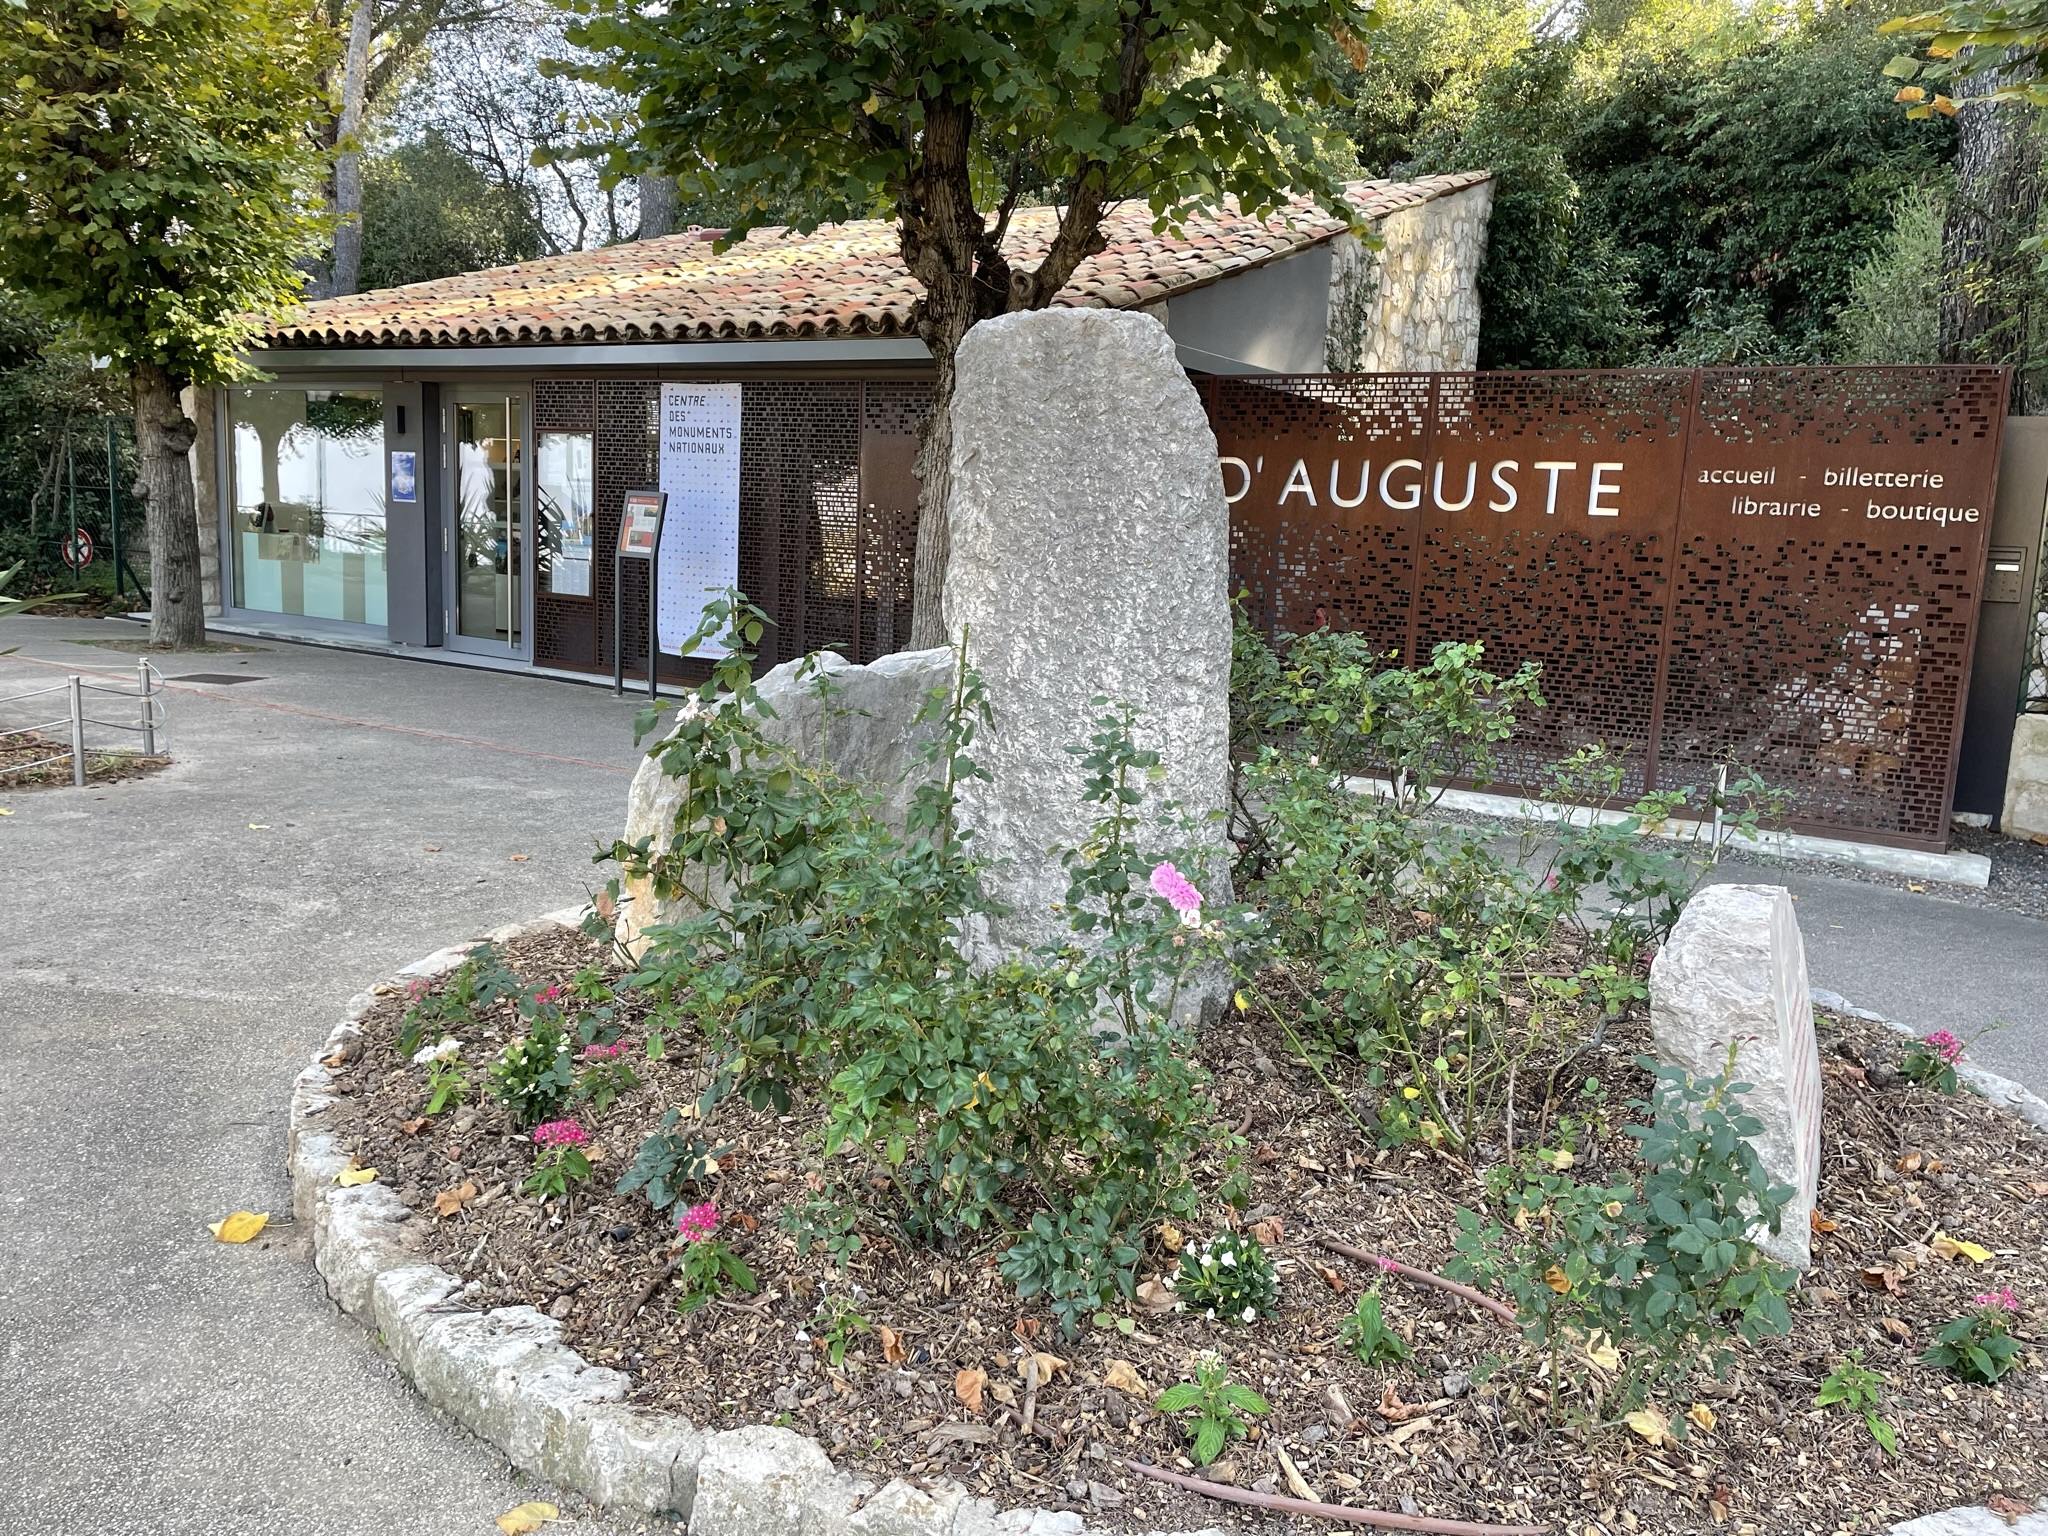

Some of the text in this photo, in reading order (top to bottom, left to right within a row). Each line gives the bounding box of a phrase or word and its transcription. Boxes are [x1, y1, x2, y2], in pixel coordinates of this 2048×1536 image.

[668, 395, 706, 407] CENTRE
[669, 410, 686, 422] DES
[669, 426, 732, 439] MONUMENTS
[669, 441, 725, 454] NATIONAUX
[1697, 466, 1776, 485] accueil
[1823, 466, 1944, 489] billetterie
[1731, 495, 1821, 517] librairie
[1866, 498, 1980, 528] boutique
